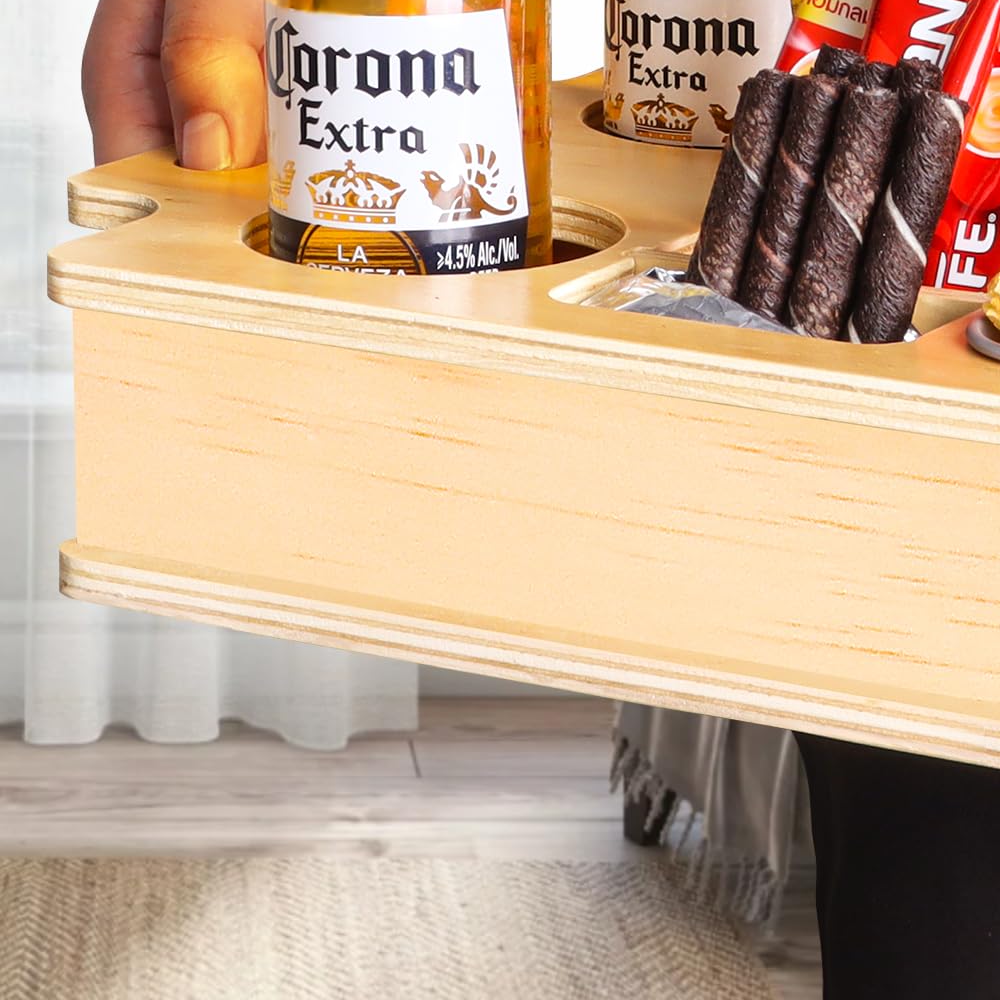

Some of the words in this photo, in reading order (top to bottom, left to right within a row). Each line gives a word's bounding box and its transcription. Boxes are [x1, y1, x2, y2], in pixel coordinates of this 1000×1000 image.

[266, 17, 481, 110] Corona
[628, 51, 707, 92] Extra
[297, 98, 427, 154] Extra
[337, 244, 369, 264] LA
[477, 235, 520, 267] Alc./Vol.
